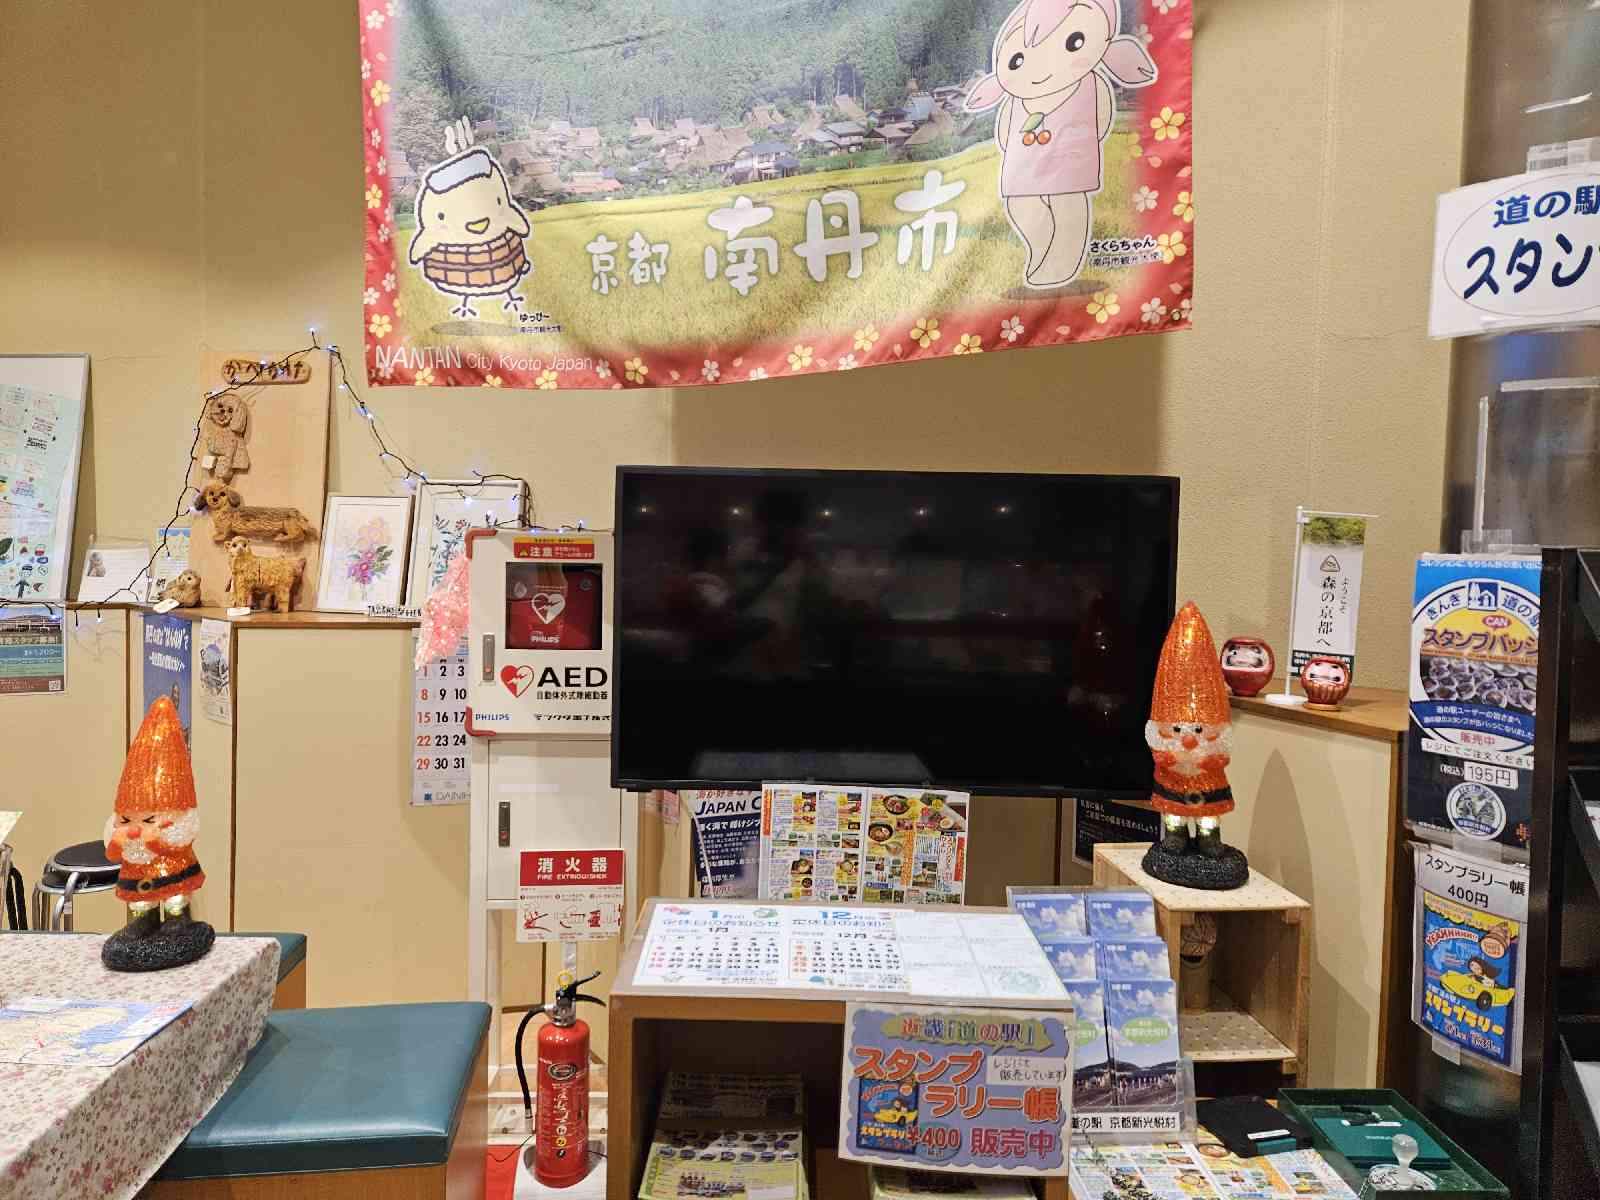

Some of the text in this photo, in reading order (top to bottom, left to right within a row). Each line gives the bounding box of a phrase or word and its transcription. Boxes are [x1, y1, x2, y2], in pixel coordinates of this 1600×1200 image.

[585, 171, 967, 296] 京都 南丹市
[1090, 240, 1154, 253] さくらちゃん
[1464, 233, 1600, 299] スタン
[375, 345, 593, 375] NANTAN City Kyoto Japan
[1339, 576, 1350, 614] ようこそ
[1317, 575, 1337, 647] 森の京都へ
[440, 666, 447, 676] 2
[457, 666, 465, 676] 3
[537, 666, 608, 688] AED
[421, 689, 467, 700] 8 9 10
[417, 712, 466, 723] 15 16 17
[475, 713, 511, 721] PHILIPS
[417, 735, 467, 746] 22 23 24
[417, 758, 465, 769] 29 30 31
[1468, 766, 1511, 787] 195円
[695, 801, 746, 815] JAPAN
[537, 857, 607, 873] 消火器
[1425, 854, 1525, 897] スタンプラリー帳
[1447, 884, 1489, 908] 400円
[854, 1048, 985, 1085] スタンプ
[924, 1085, 1062, 1123] ラリー帳
[970, 1128, 1056, 1159] 販売中
